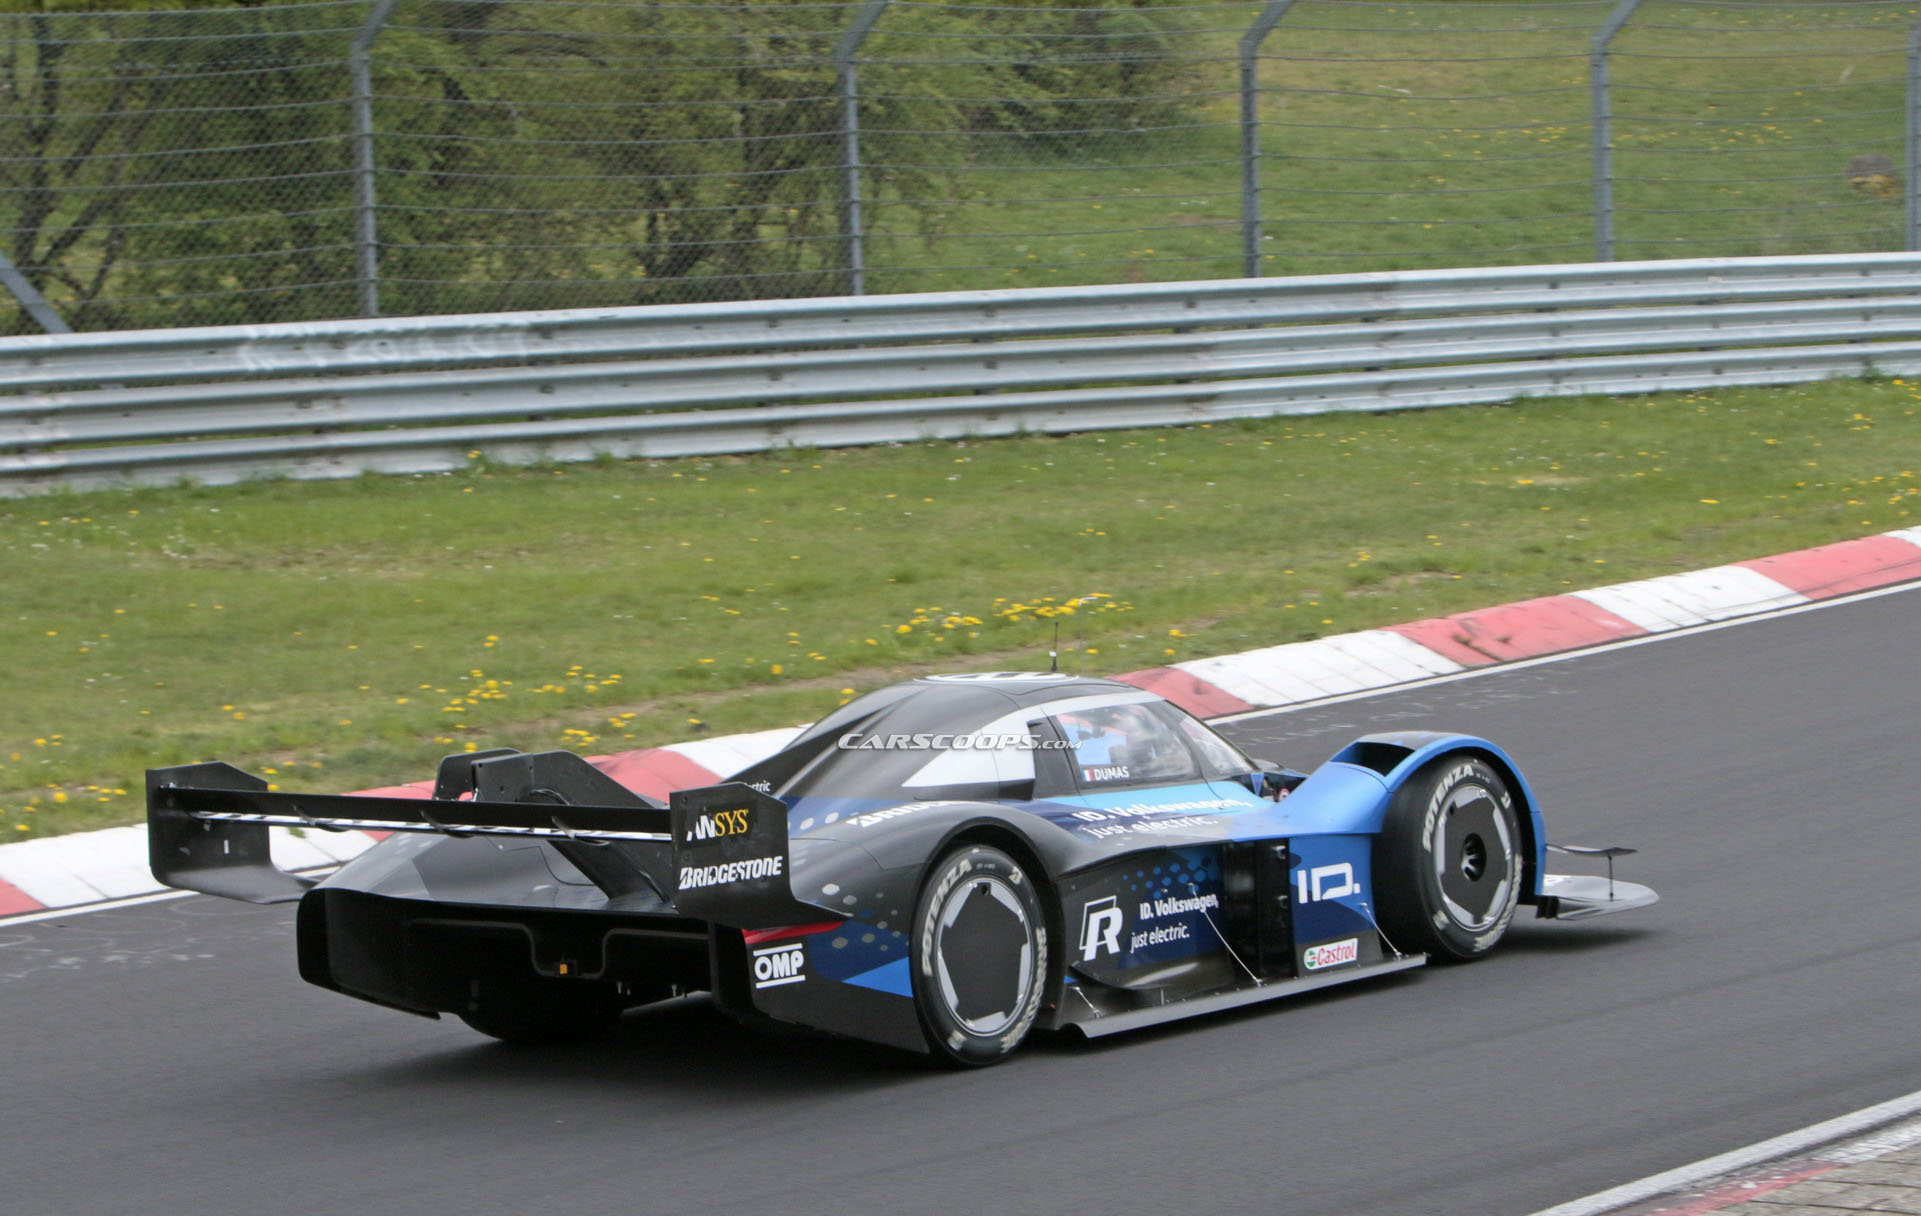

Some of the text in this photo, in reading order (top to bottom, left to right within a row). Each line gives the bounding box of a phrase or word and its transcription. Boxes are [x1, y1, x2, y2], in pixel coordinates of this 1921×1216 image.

[1093, 766, 1130, 781] DUMAS
[686, 808, 749, 842] ANSYS
[678, 855, 783, 890] BRIDGESTONE
[921, 858, 973, 977] POTENZA
[1082, 904, 1123, 962] R
[1130, 926, 1147, 954] just
[1317, 942, 1356, 967] Castrol
[754, 950, 805, 981] OMP
